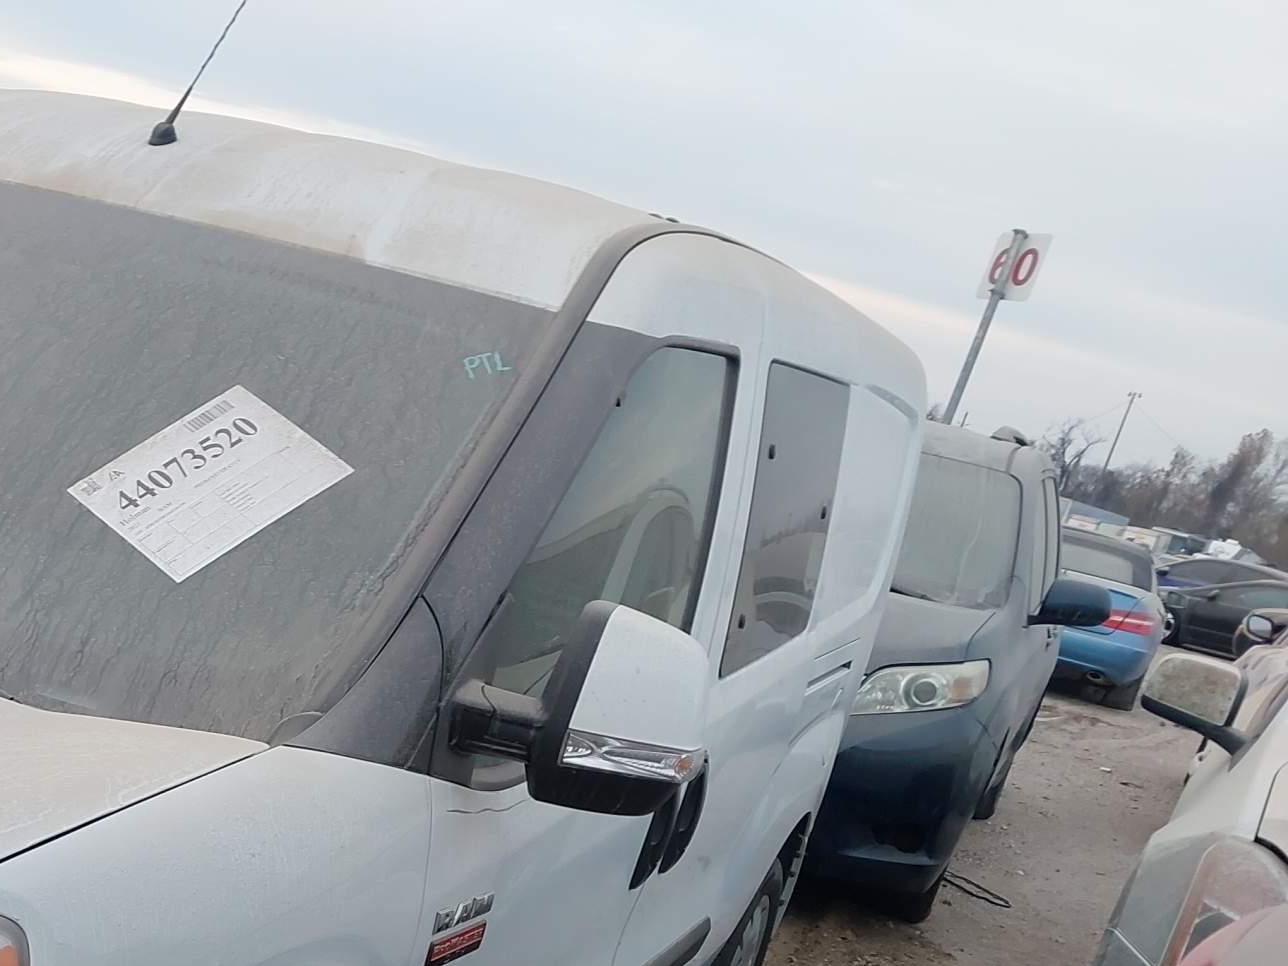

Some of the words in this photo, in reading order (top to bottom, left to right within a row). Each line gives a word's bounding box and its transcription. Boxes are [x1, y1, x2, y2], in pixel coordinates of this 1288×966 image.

[988, 246, 1039, 287] 60
[463, 351, 513, 380] PTL
[116, 416, 259, 512] 44073520
